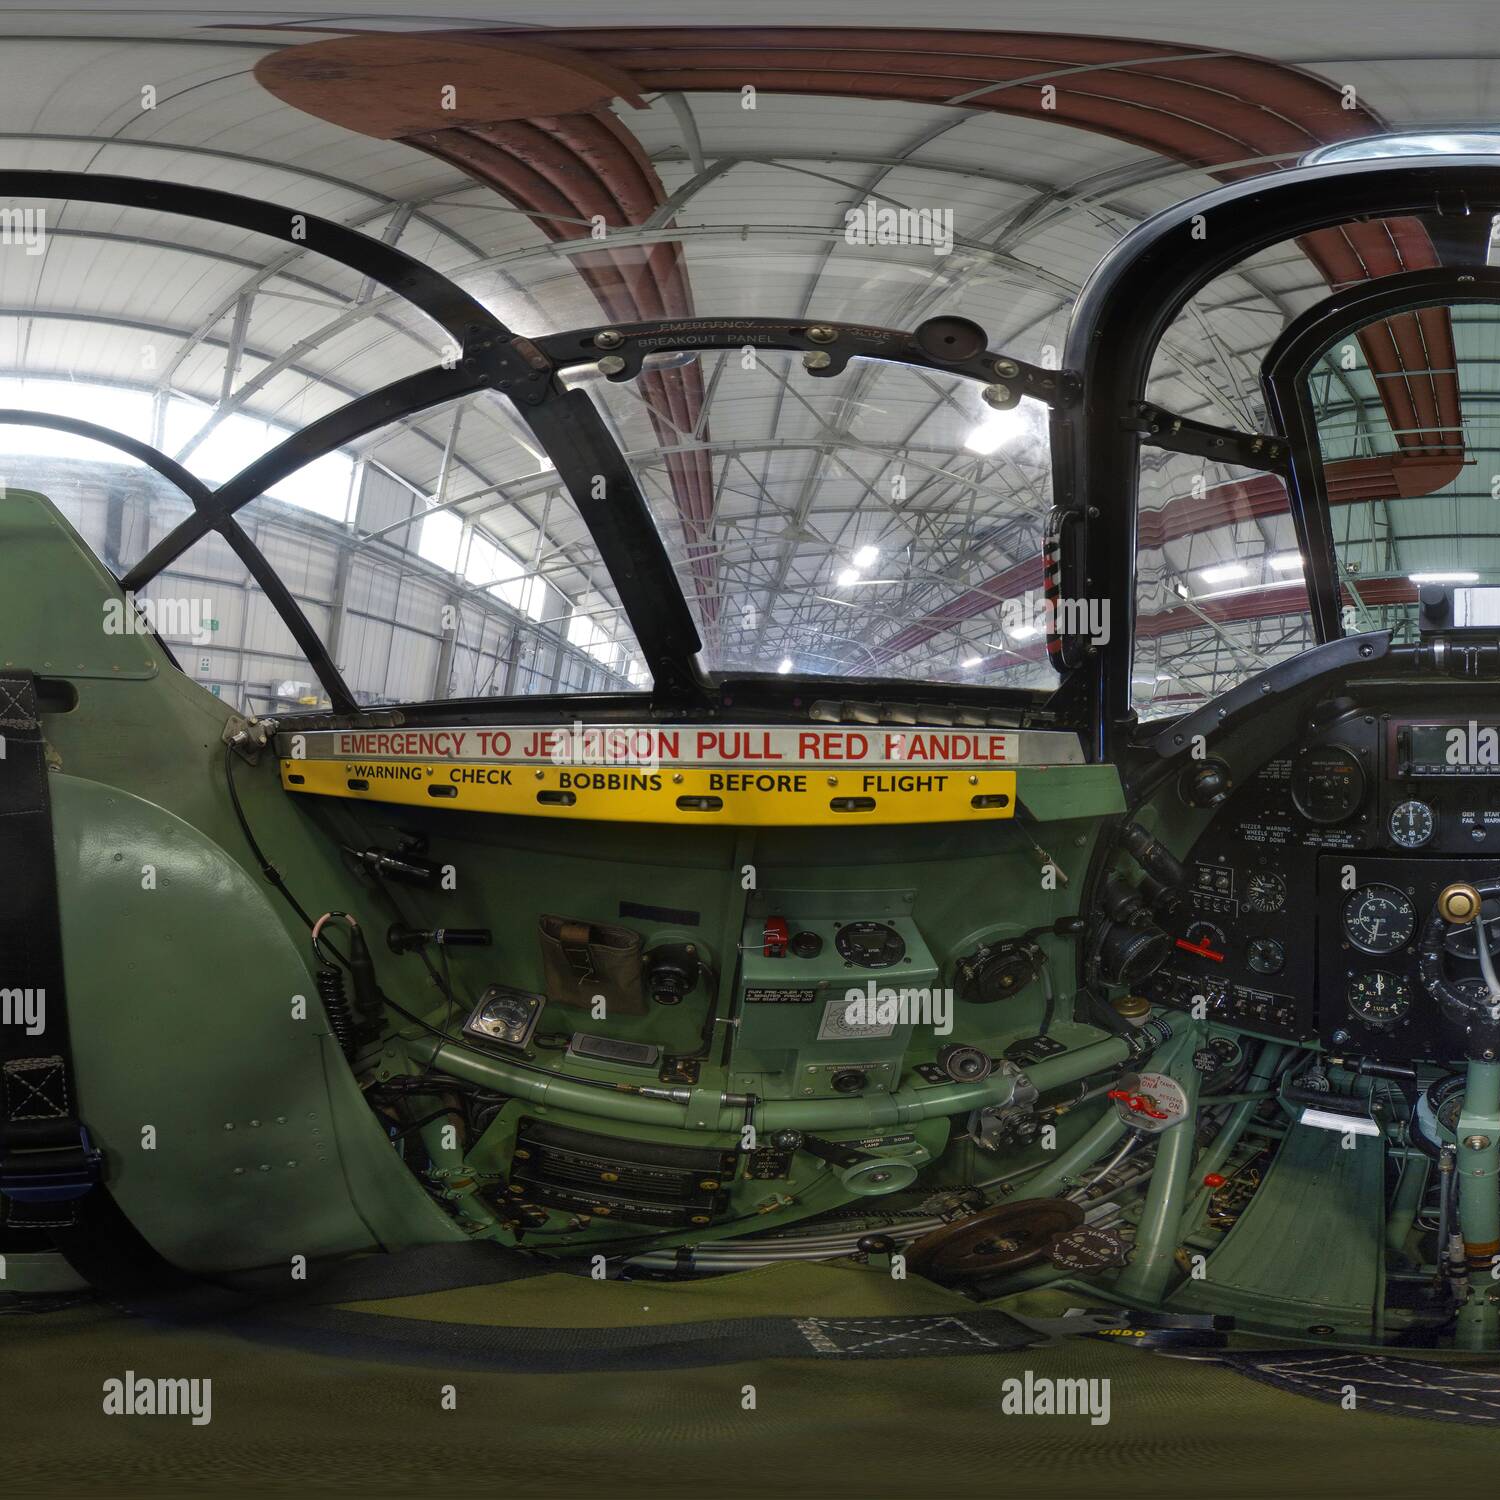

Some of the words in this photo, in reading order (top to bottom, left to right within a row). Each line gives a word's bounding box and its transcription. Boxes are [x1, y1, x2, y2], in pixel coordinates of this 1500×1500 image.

[638, 335, 716, 347] BREAKOUT
[727, 334, 776, 343] PANEL
[341, 732, 466, 755] EMERGENCY
[477, 732, 512, 757] TO
[696, 731, 783, 759] PULL
[799, 732, 868, 760] RED
[885, 733, 1006, 760] HANDLE
[354, 765, 422, 781] WARNING
[449, 768, 512, 786] CHECK
[559, 772, 662, 791] BOBBINS
[709, 773, 808, 793] BEFORE
[863, 775, 948, 793] FLIGHT
[1266, 825, 1291, 833] WARNING
[1391, 931, 1400, 939] 25
[1358, 983, 1365, 991] 8
[1396, 986, 1403, 995] 2
[1141, 1080, 1153, 1088] ON
[1159, 1080, 1177, 1090] TANKS
[1168, 1102, 1181, 1110] ON
